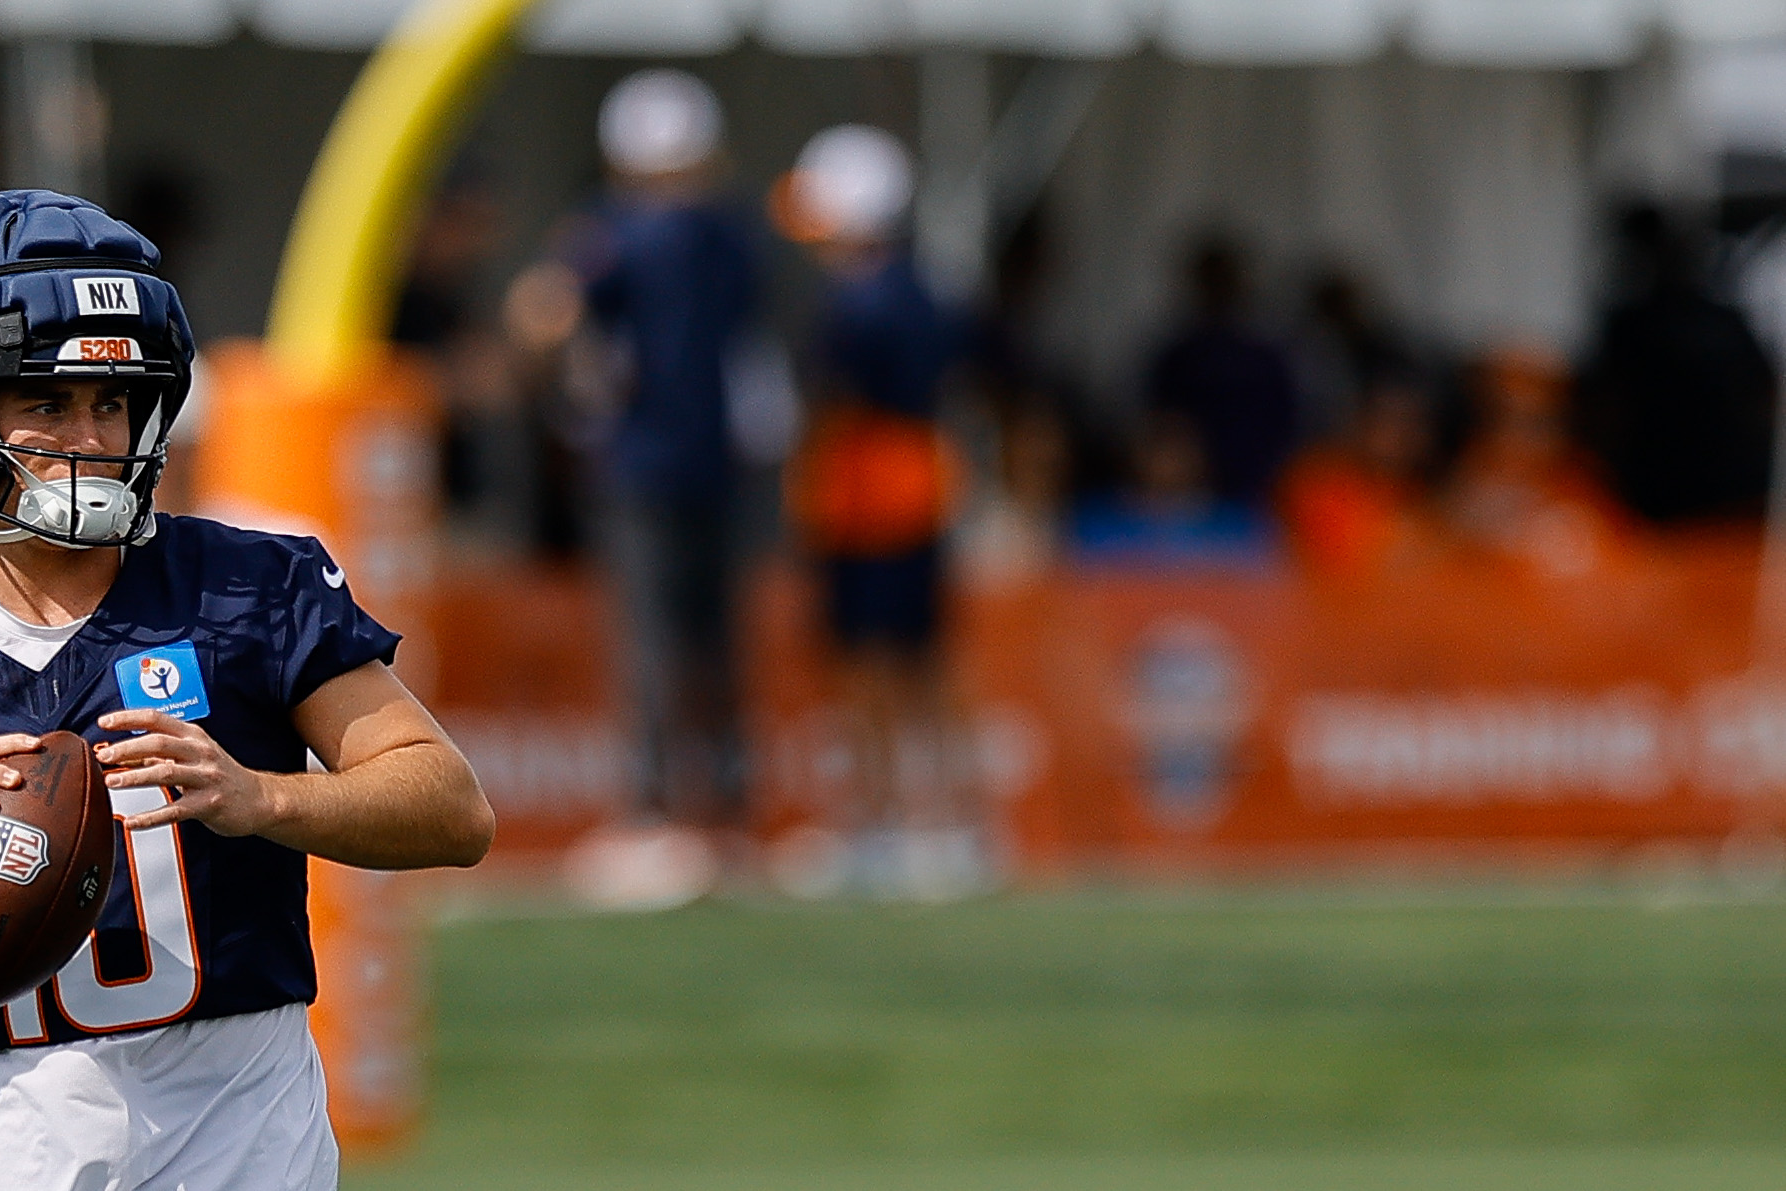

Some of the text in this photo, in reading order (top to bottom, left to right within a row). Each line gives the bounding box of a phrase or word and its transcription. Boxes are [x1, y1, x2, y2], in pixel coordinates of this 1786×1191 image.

[87, 283, 129, 309] NIX
[80, 339, 132, 361] 5280
[1, 834, 41, 878] NFL
[4, 767, 202, 1045] 0
